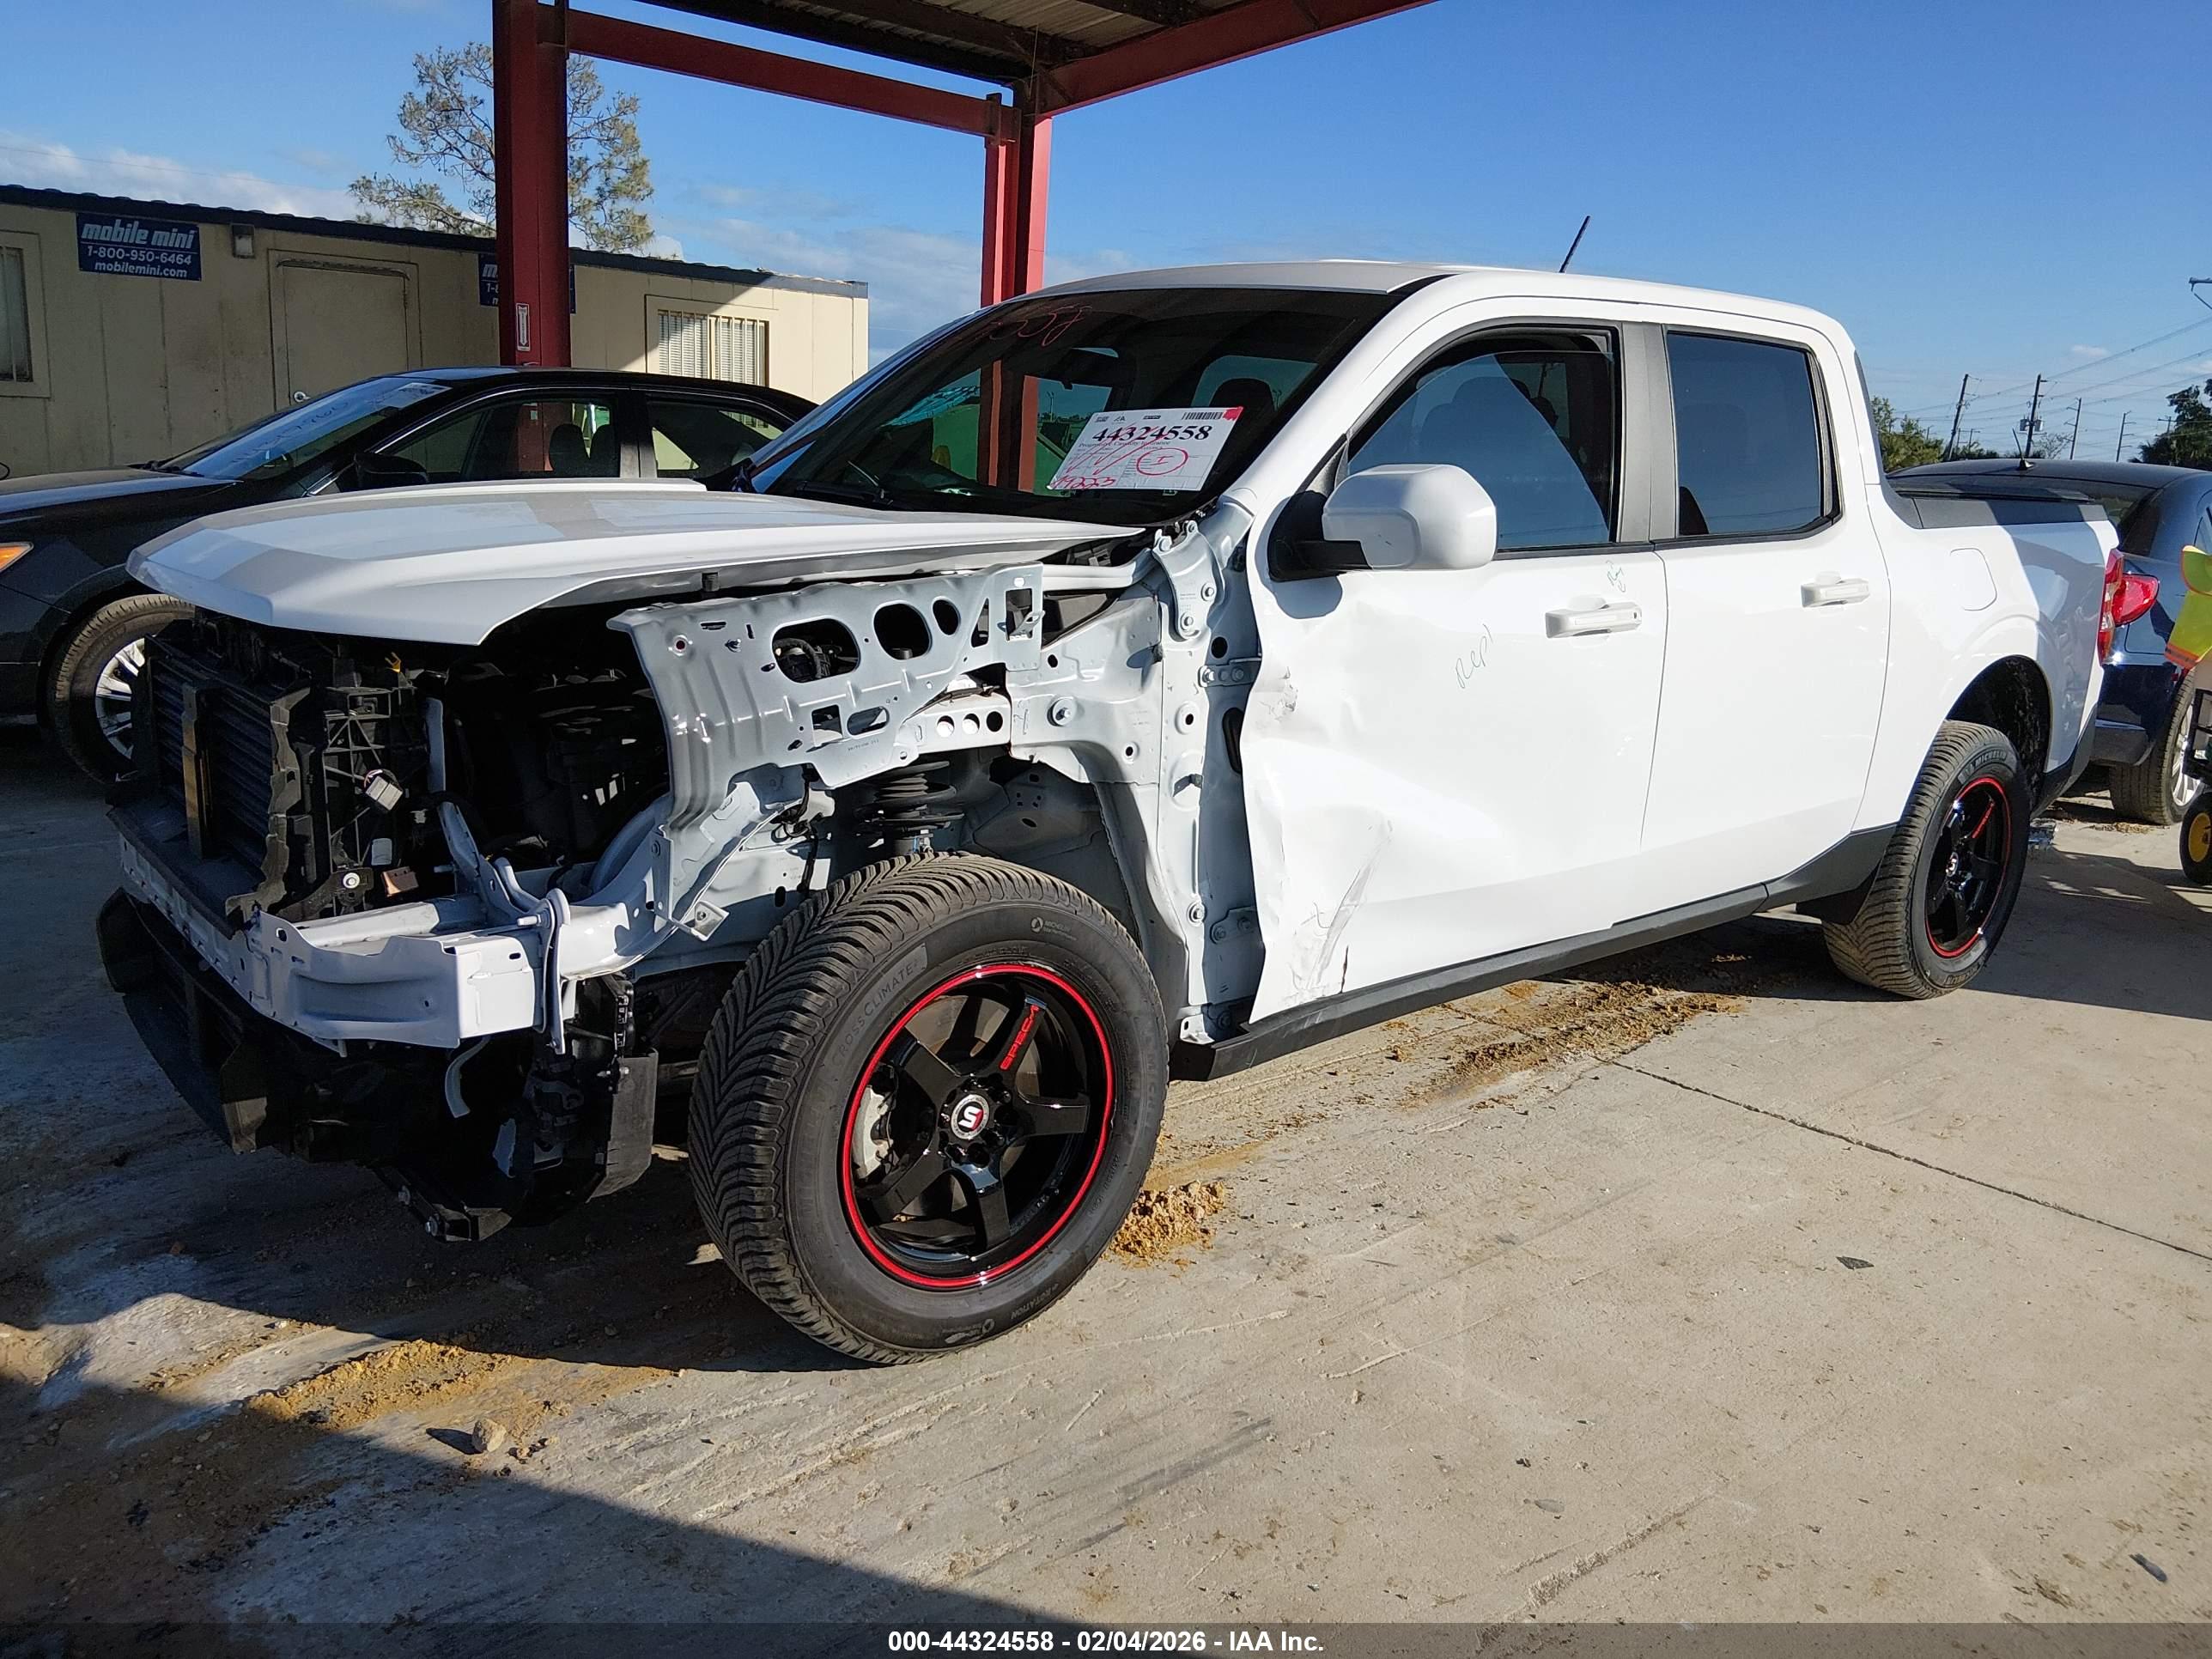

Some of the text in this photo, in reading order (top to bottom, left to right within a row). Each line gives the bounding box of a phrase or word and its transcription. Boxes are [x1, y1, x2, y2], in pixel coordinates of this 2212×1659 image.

[81, 219, 198, 248] mobile mini
[87, 246, 192, 265] 1-800-950-6464
[94, 261, 187, 277] mobilemini.com
[1092, 425, 1213, 441] 44324558
